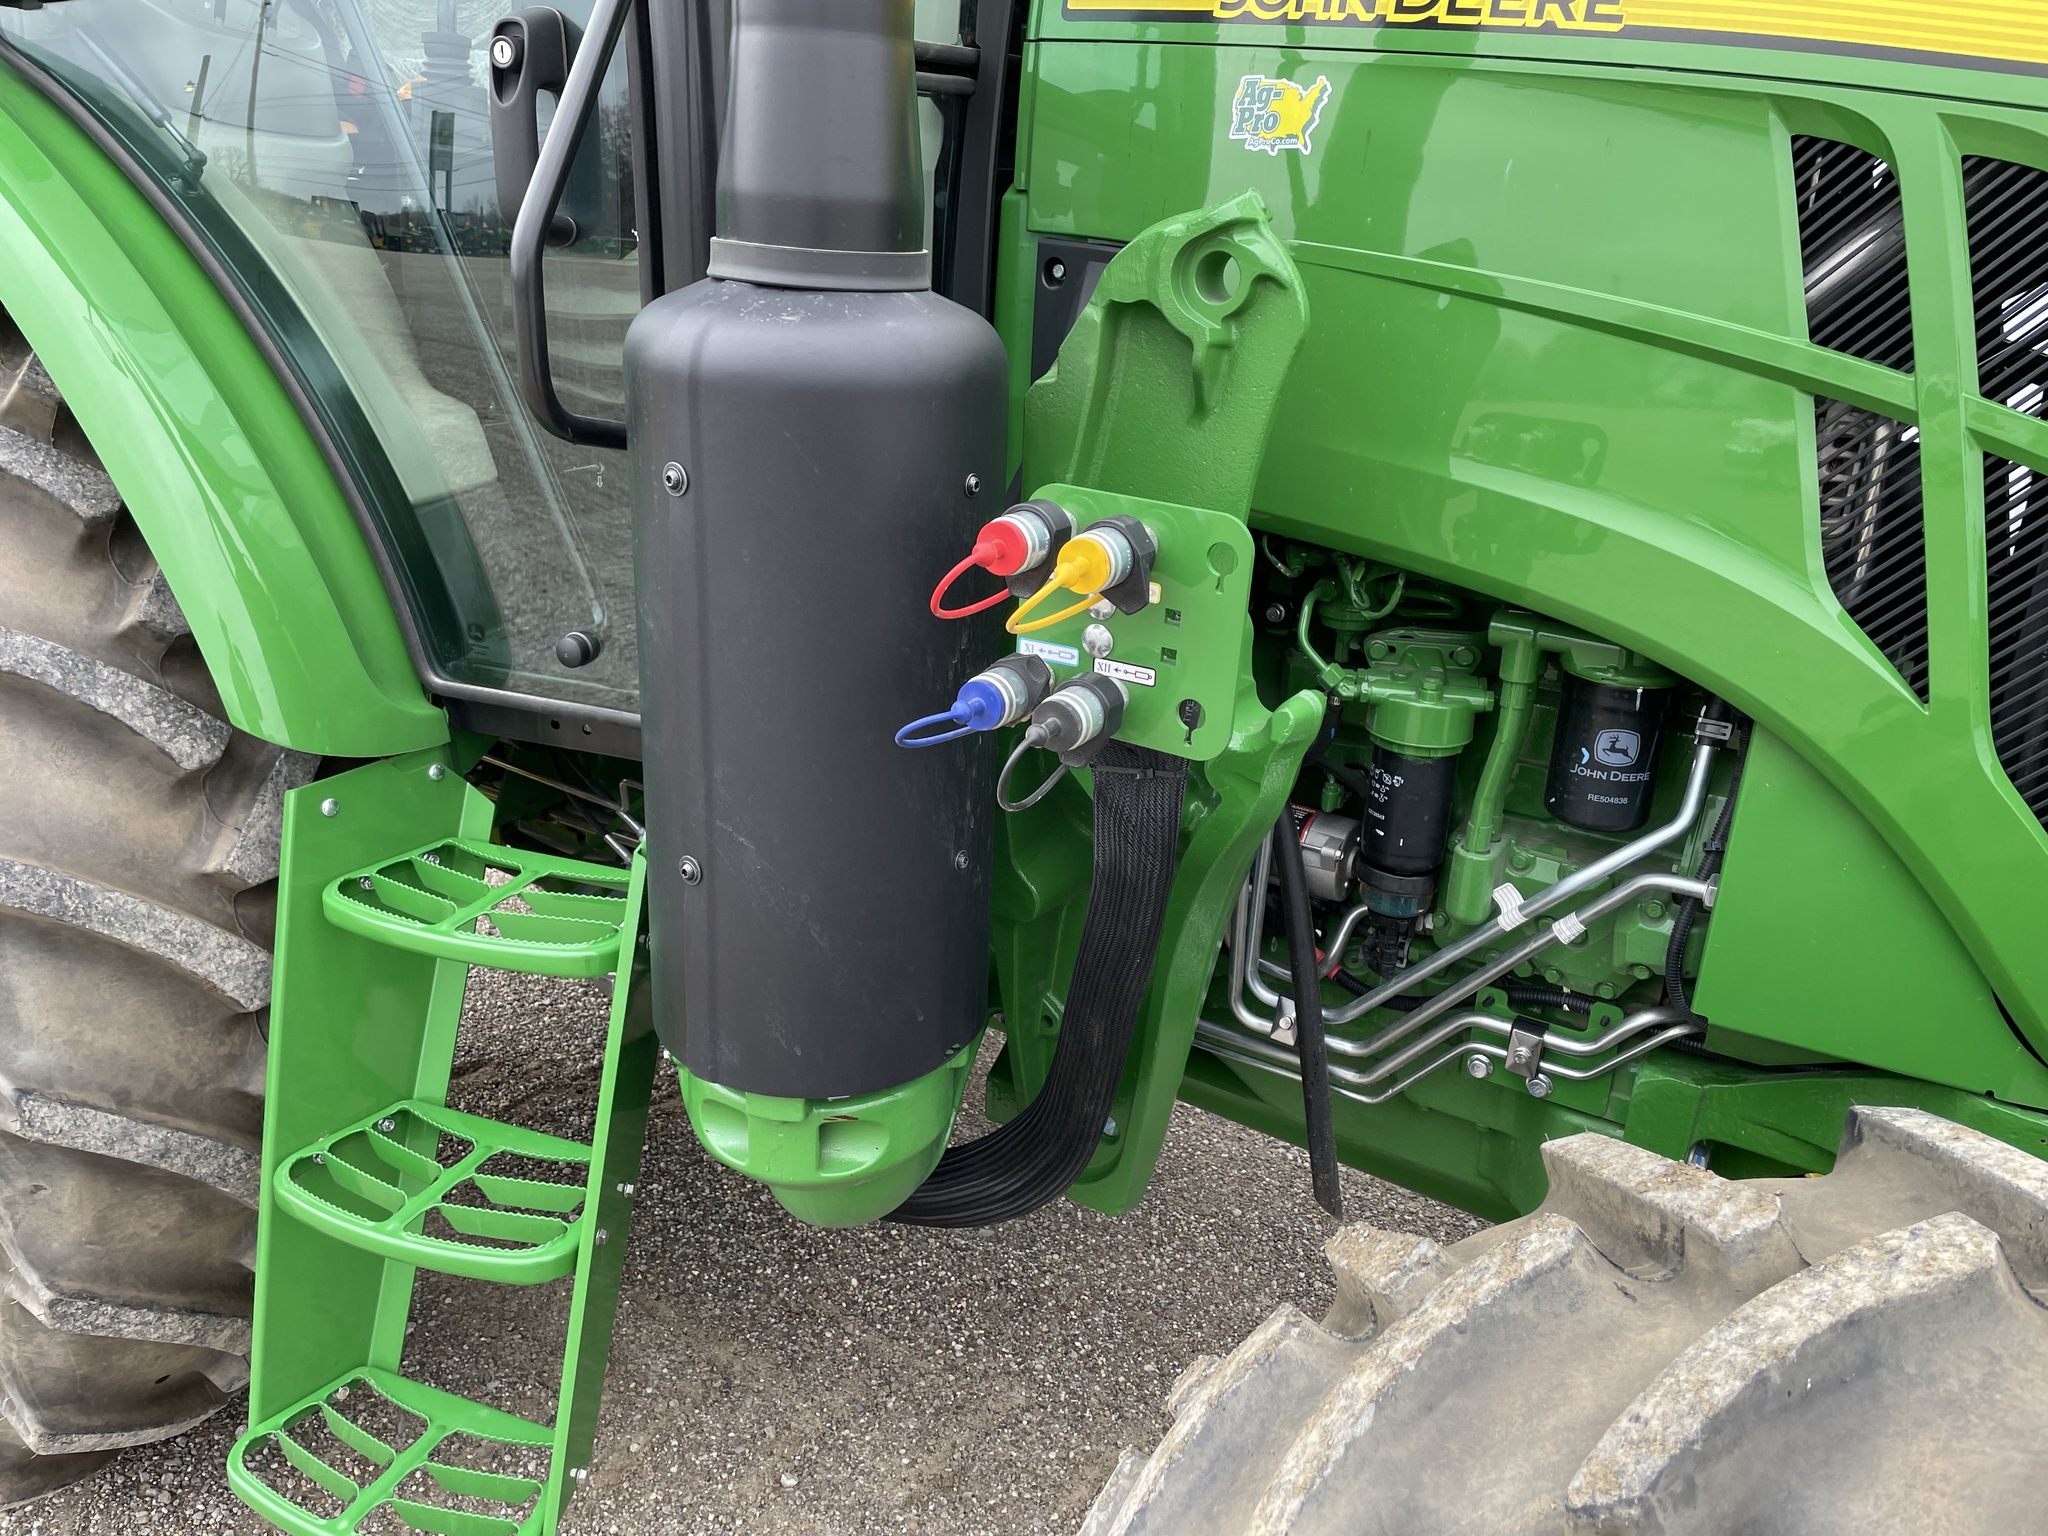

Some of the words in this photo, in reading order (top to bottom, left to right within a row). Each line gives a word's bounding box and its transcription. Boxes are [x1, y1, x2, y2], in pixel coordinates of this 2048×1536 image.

[1237, 80, 1284, 112] Ag-
[1234, 107, 1280, 133] Pro
[1249, 137, 1298, 147] AgProCo.com
[1024, 643, 1034, 654] XI
[1096, 662, 1111, 673] XII
[1570, 764, 1607, 780] JOHN
[1610, 771, 1651, 782] DEERE
[1587, 793, 1628, 804] RE504836
